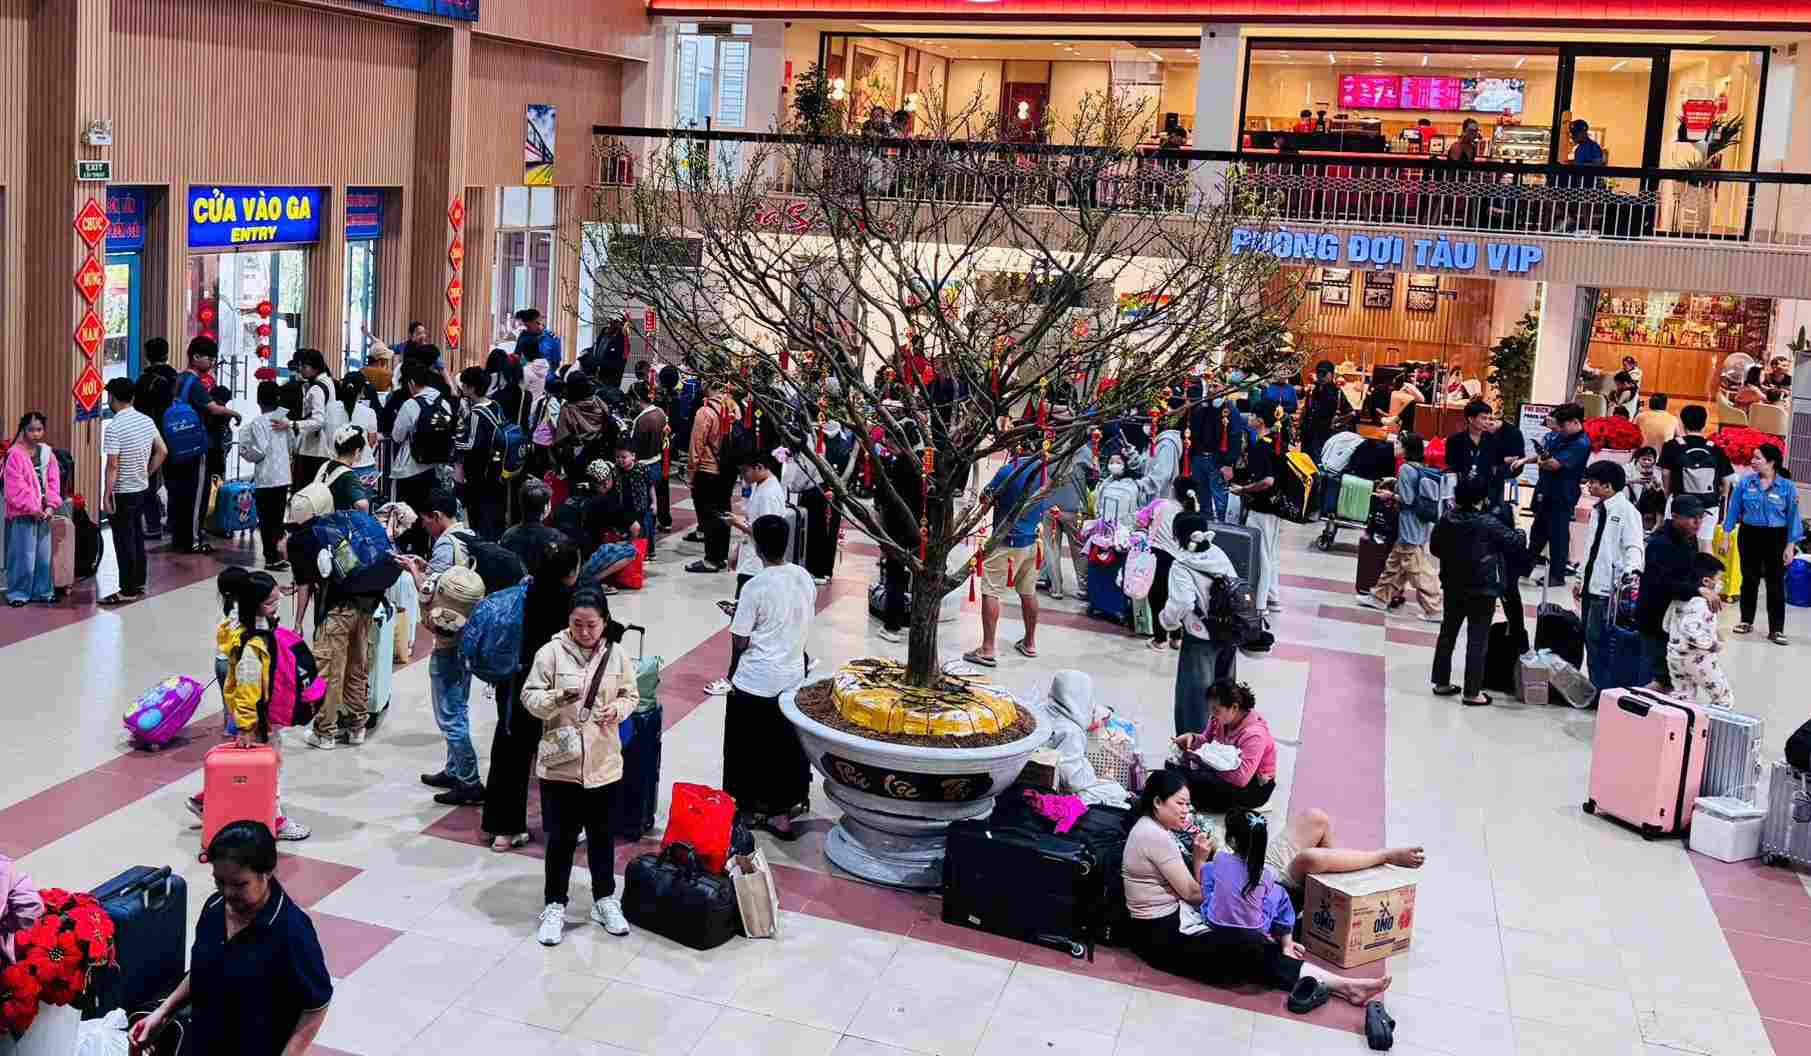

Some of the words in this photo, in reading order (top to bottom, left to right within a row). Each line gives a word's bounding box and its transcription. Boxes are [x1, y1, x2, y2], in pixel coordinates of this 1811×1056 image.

[193, 187, 237, 224] CỬA
[242, 191, 282, 222] VÀO
[286, 195, 312, 220] GA
[231, 226, 278, 242] ENTRY
[1349, 233, 1404, 271] ĐỢI
[1413, 234, 1478, 270] TÀU
[1487, 243, 1545, 272] VIP
[1374, 915, 1394, 934] OMO
